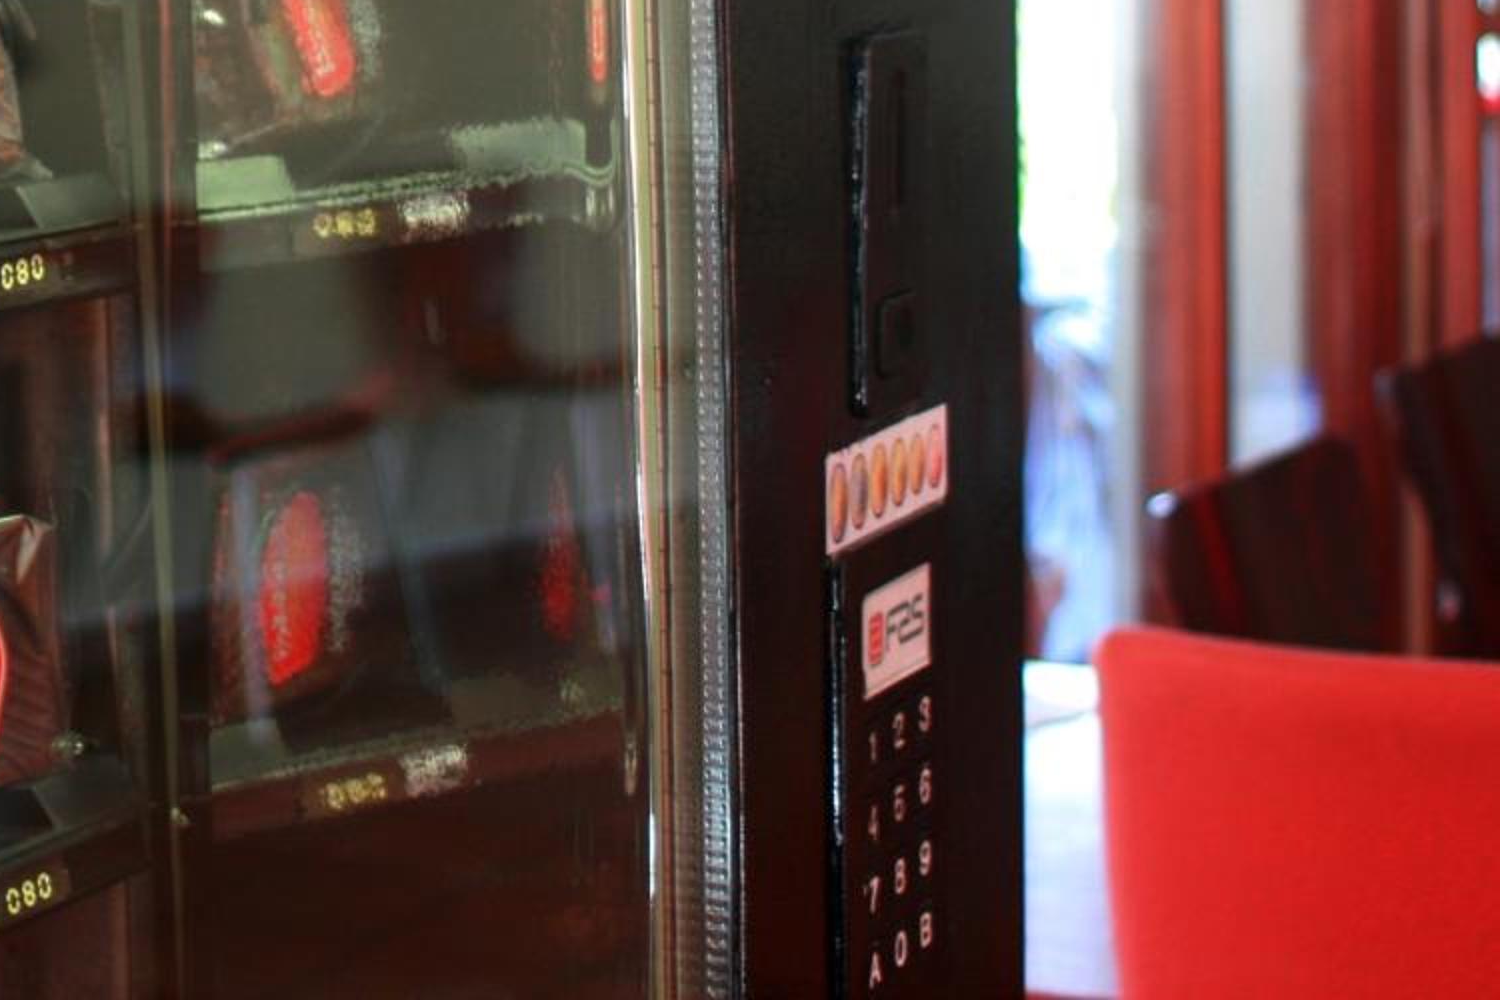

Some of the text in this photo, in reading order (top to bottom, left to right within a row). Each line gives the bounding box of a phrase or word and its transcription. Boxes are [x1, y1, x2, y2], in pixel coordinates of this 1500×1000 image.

[0, 253, 45, 289] 080
[867, 695, 932, 764] 1 2 3
[918, 766, 933, 805] 6
[5, 873, 53, 916] 080
[867, 839, 933, 914] 7 8 9
[867, 951, 883, 989] A
